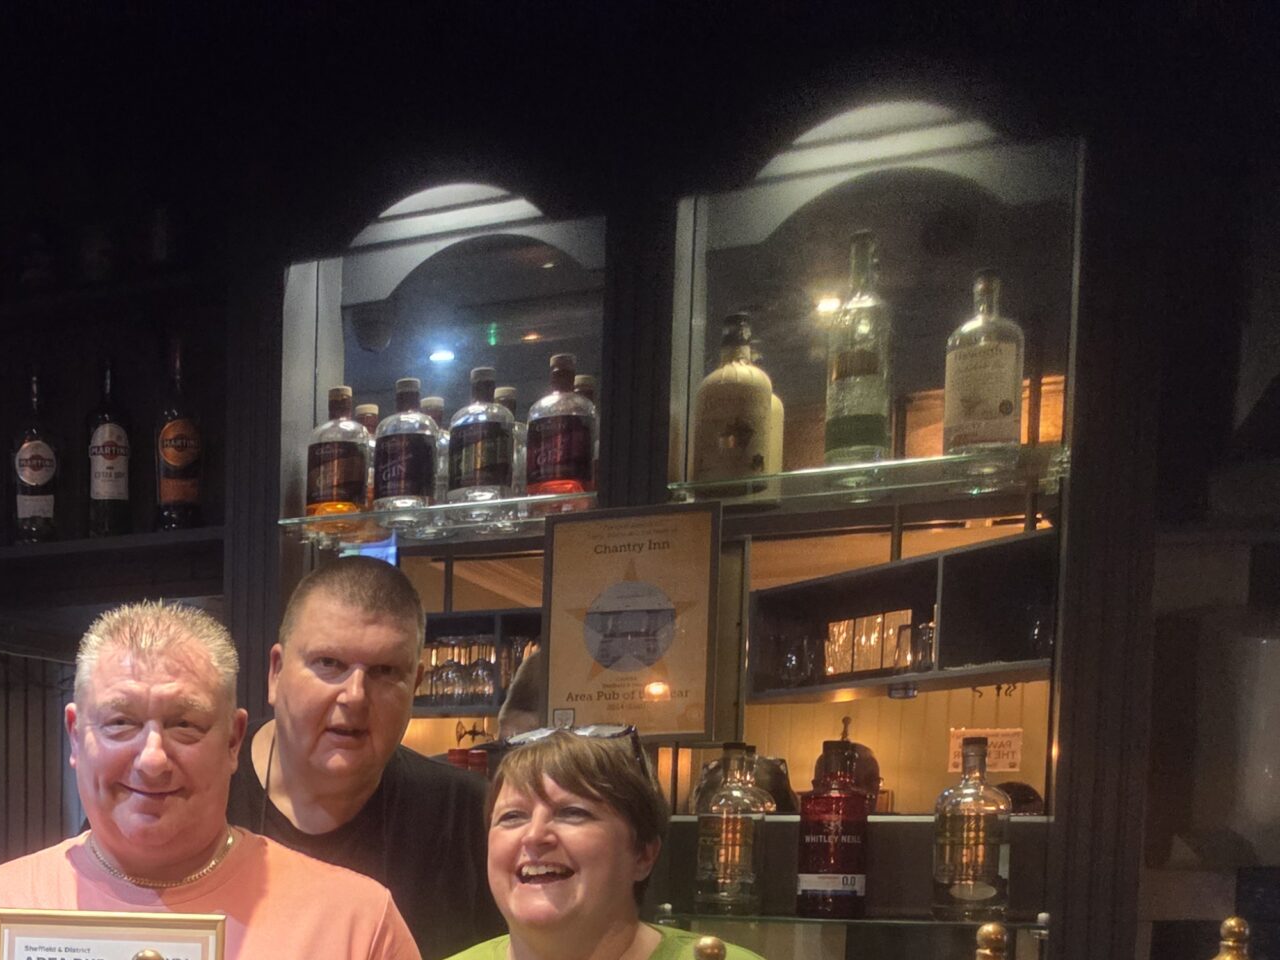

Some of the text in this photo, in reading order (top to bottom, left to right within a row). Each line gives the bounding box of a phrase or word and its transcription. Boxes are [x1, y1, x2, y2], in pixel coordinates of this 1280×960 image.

[594, 539, 670, 555] Chantry Inn
[566, 691, 593, 702] Area
[596, 690, 617, 701] Pub
[622, 690, 635, 700] of
[805, 835, 862, 844] WHITLEY NEILL
[842, 875, 857, 887] 0.0
[24, 945, 57, 953] Sheffield
[64, 946, 91, 954] District
